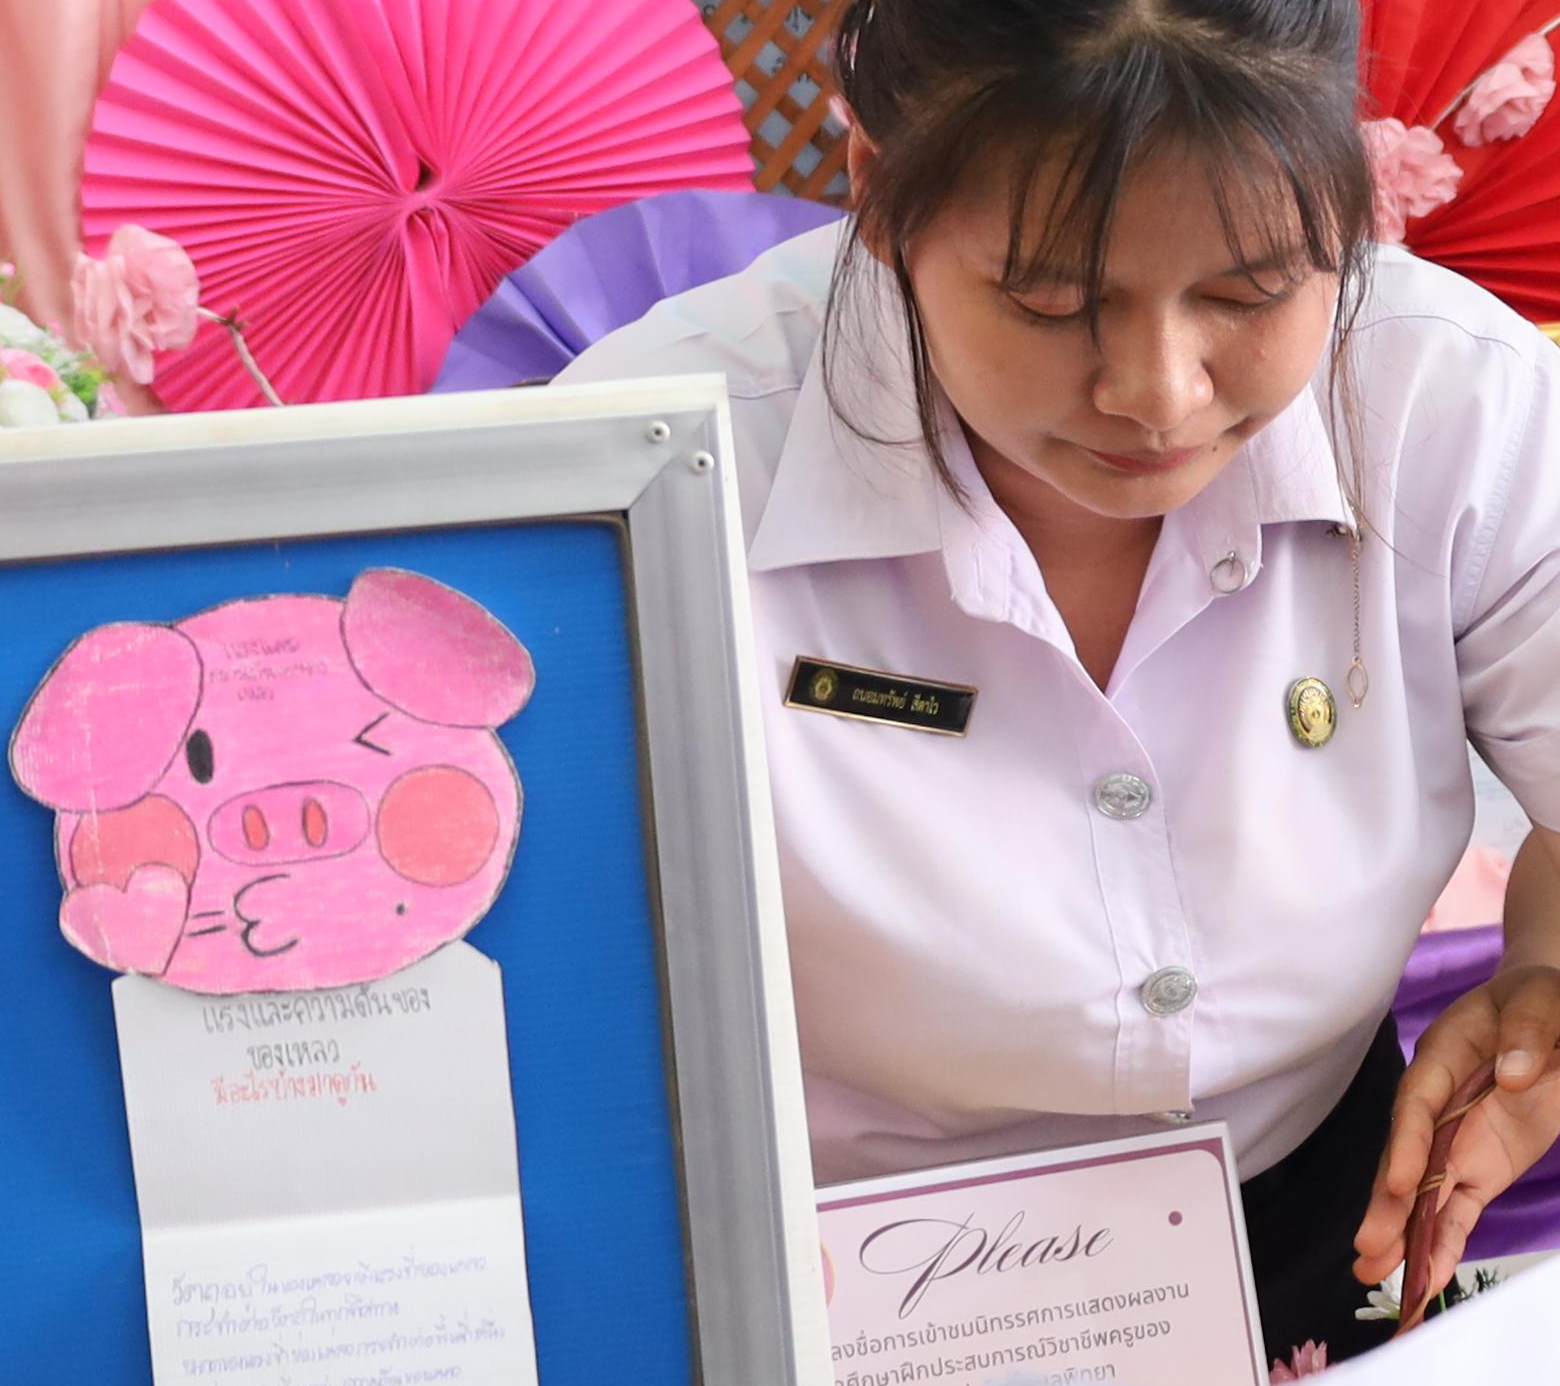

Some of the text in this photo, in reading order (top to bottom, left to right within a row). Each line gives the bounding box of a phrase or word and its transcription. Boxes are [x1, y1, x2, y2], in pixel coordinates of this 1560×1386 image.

[246, 1038, 340, 1071] ของเหลว
[858, 1210, 1115, 1320] Please
